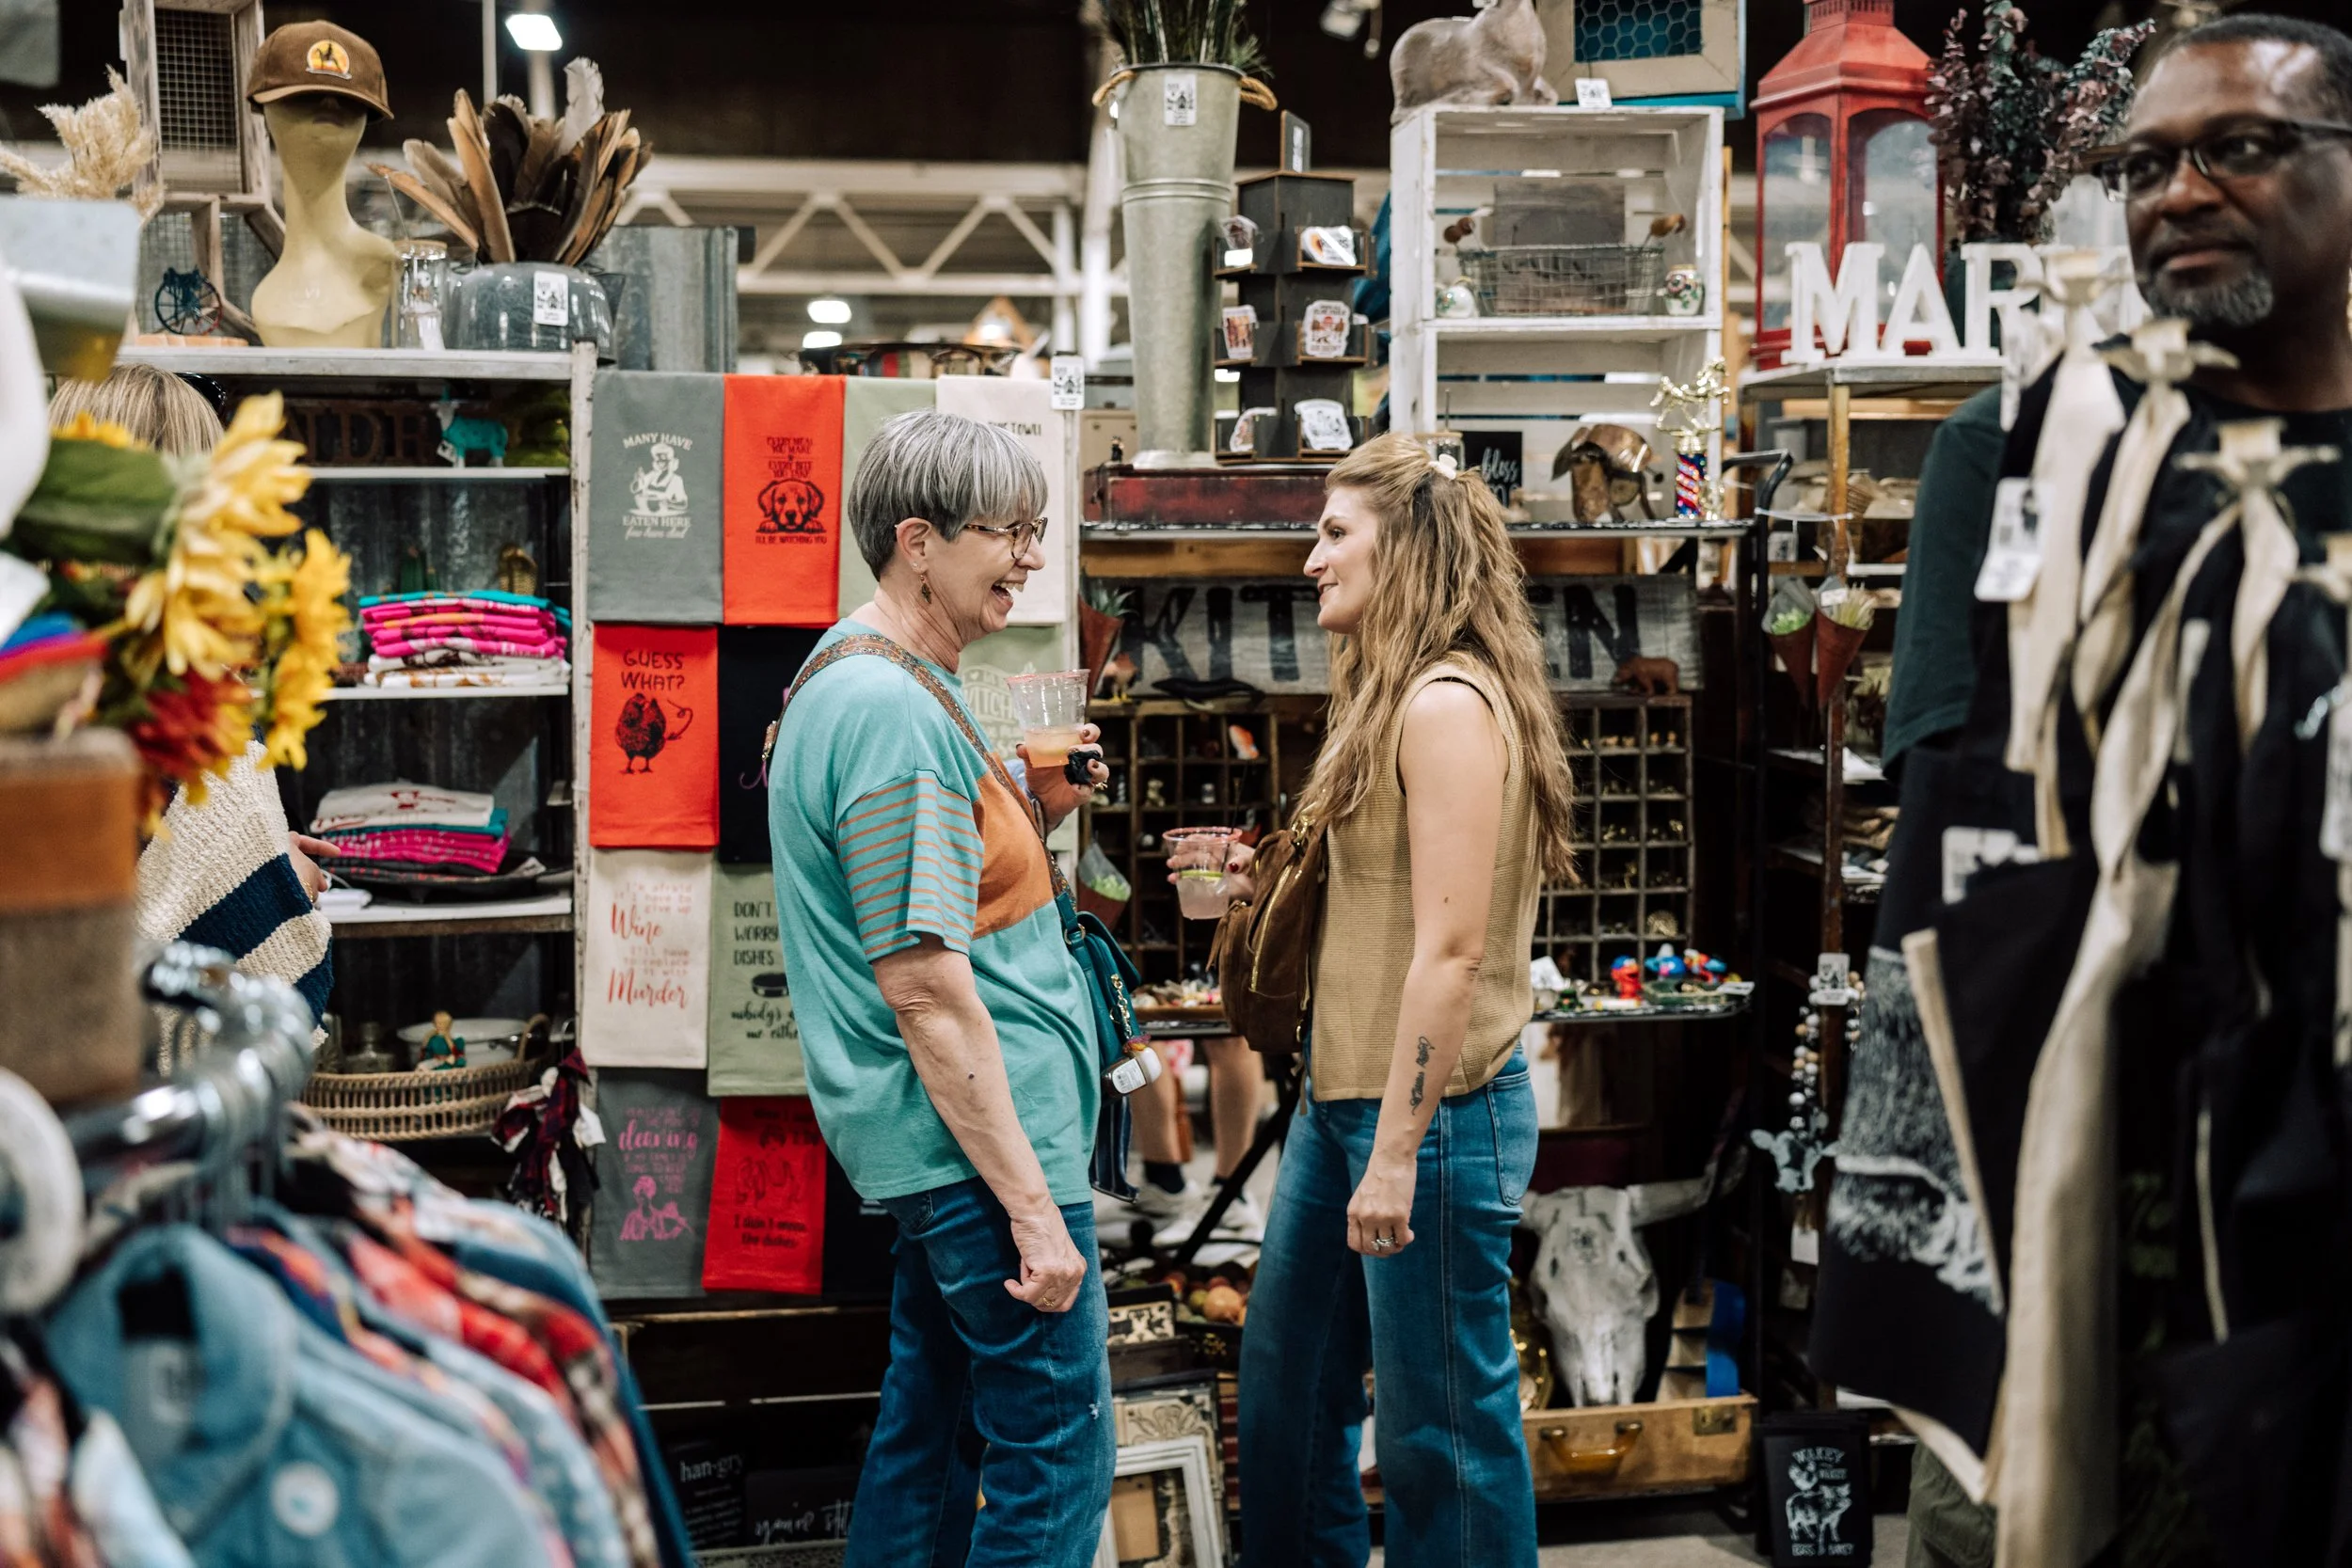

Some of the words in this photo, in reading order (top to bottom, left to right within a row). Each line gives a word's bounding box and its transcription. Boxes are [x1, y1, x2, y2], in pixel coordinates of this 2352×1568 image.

[623, 433, 658, 449] MANY
[660, 434, 692, 451] HAVE
[623, 515, 659, 527] EATEN
[660, 516, 691, 528] HERE
[1121, 584, 1640, 681] KITN
[623, 650, 685, 669] GUESS
[621, 671, 685, 690] WHAT?
[734, 900, 771, 918] DON'T
[611, 902, 662, 944] Wine
[733, 949, 774, 966] DISHES
[608, 968, 687, 1009] Murder
